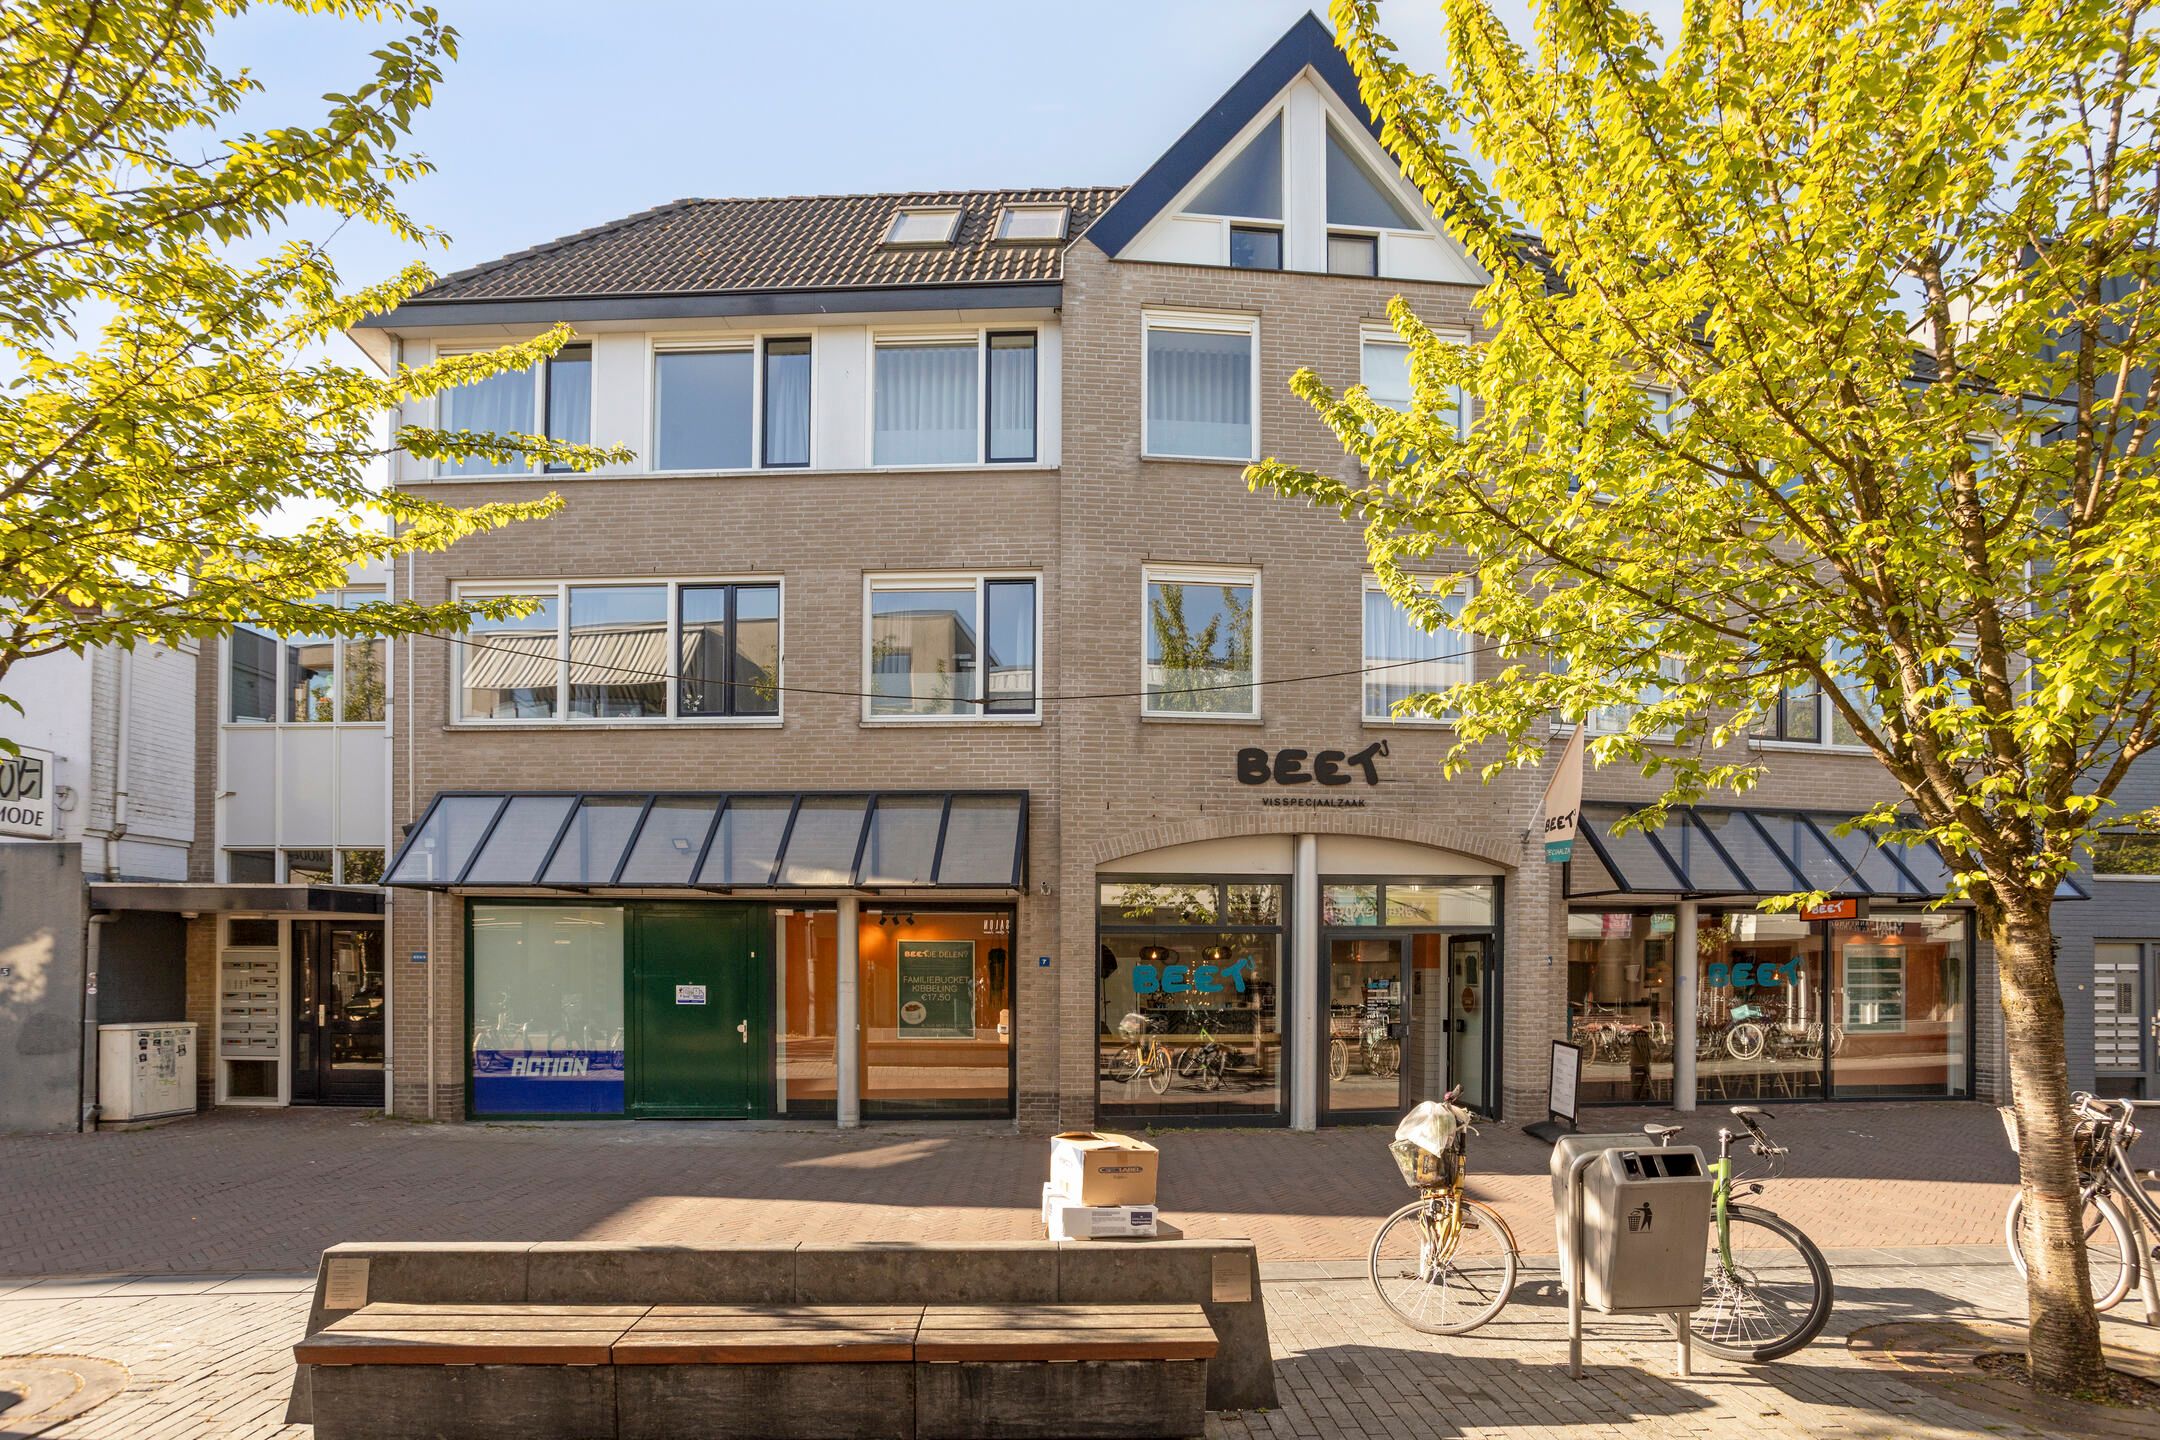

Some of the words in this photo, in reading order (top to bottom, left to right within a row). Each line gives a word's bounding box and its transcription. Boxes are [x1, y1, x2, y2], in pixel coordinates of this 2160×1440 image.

[1237, 741, 1383, 786] BEET
[1262, 797, 1366, 807] VISSPECIAALZAAK
[1545, 810, 1574, 833] BEET
[1811, 901, 1843, 914] BEET
[938, 950, 968, 958] DELEN?
[903, 976, 970, 984] FAMILIEBUCKET
[1132, 957, 1248, 993] BEET
[1708, 955, 1801, 987] BEET
[511, 1057, 589, 1077] ACTION
